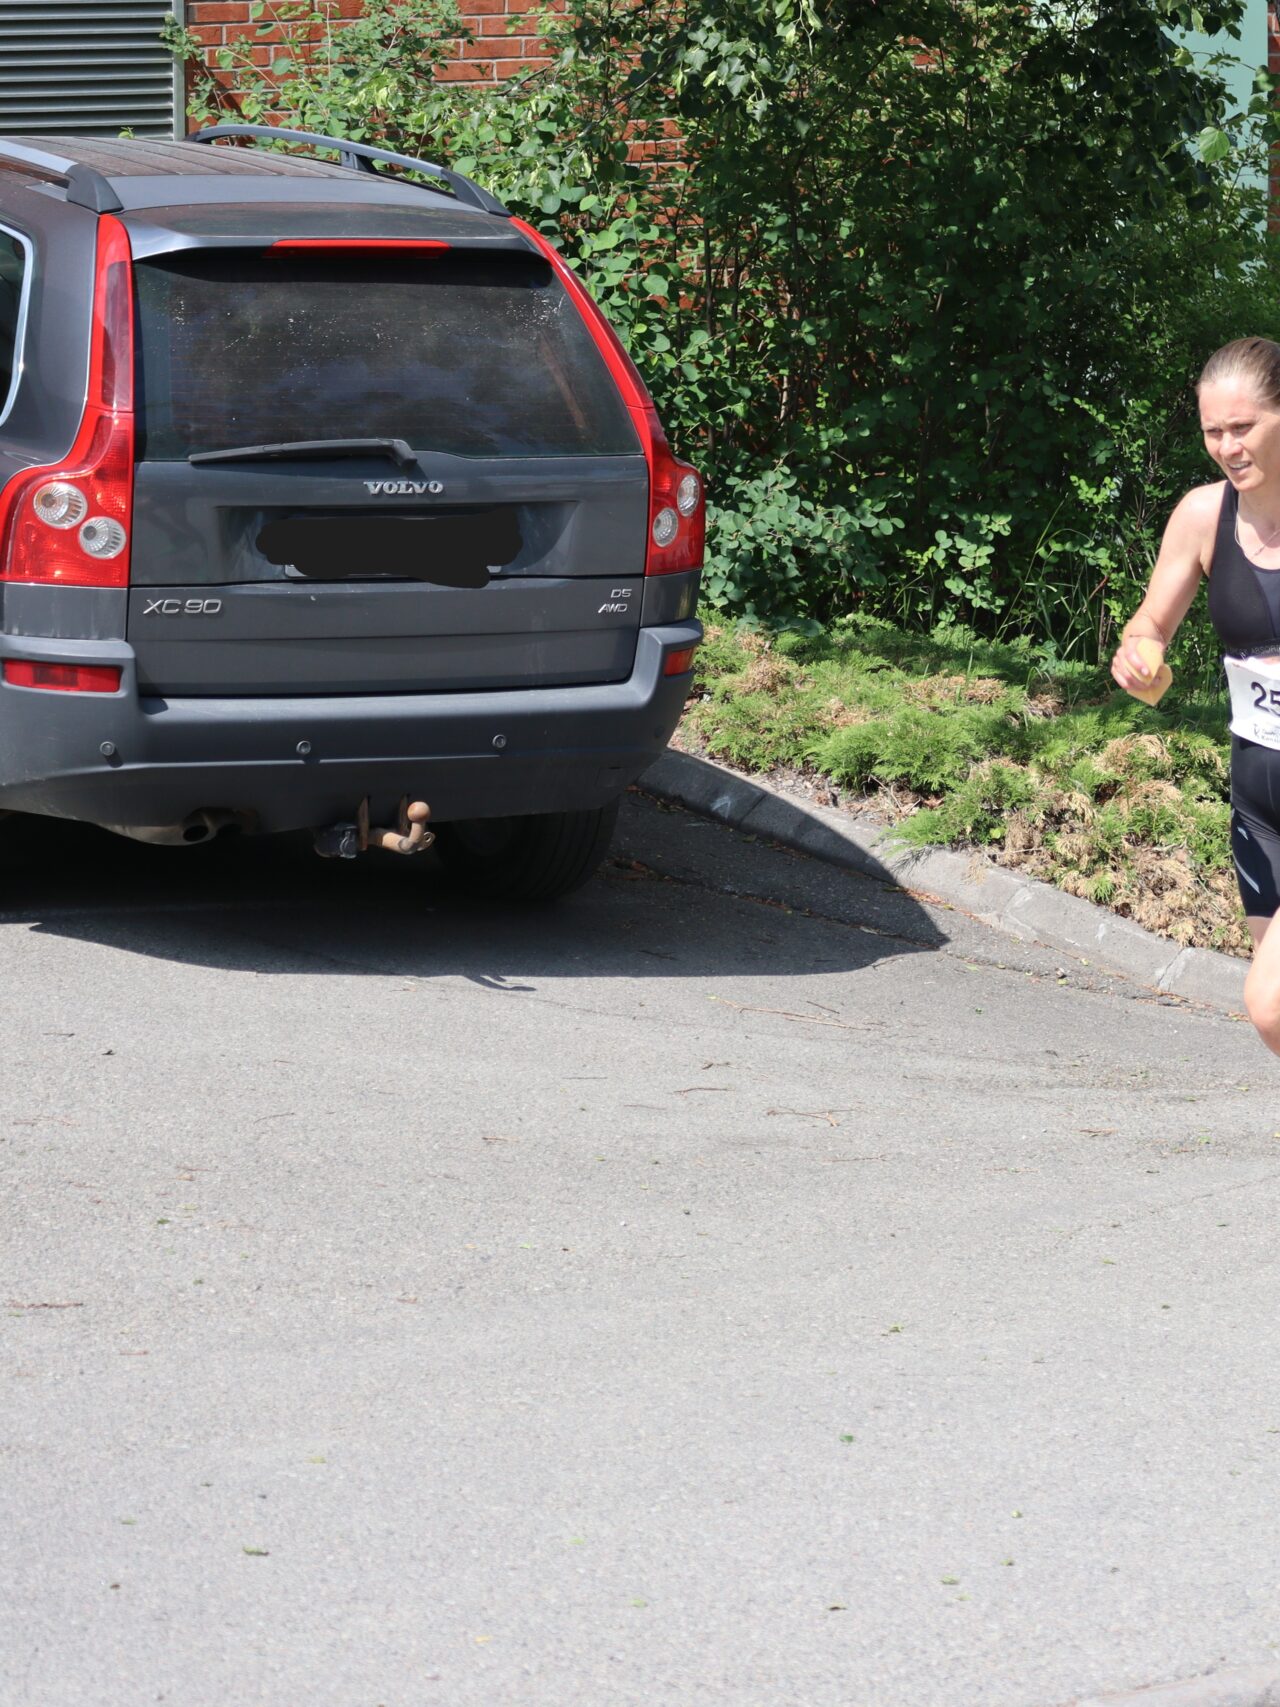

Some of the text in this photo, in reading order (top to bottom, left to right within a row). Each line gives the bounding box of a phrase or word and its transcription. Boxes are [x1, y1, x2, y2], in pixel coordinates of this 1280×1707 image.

[363, 480, 444, 495] VOLVO
[610, 588, 632, 598] D5
[598, 603, 628, 613] AWD
